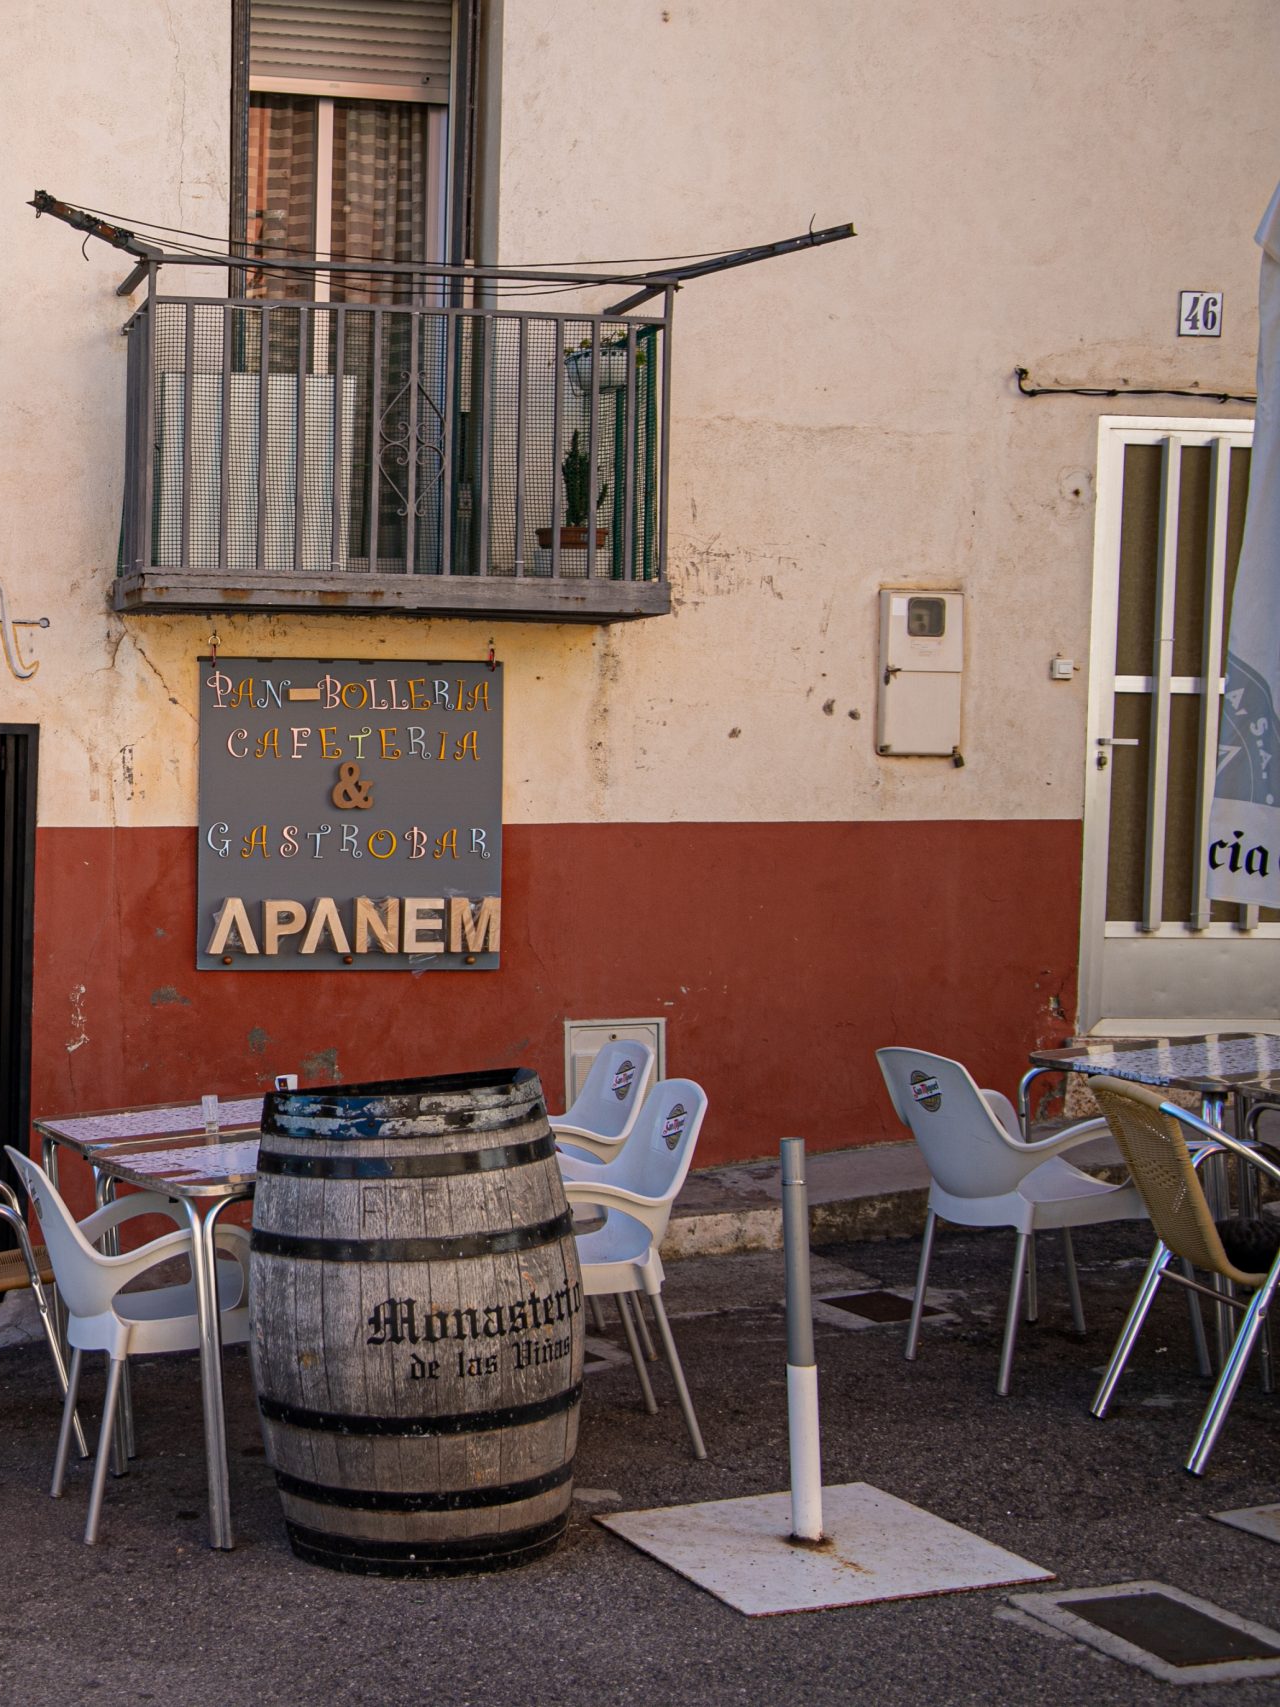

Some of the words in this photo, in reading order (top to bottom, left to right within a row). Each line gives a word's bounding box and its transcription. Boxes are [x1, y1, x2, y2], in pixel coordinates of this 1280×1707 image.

[1184, 296, 1218, 331] 46
[227, 726, 481, 761] CAFETERIA
[332, 760, 374, 809] &
[207, 821, 491, 860] GASTROBAR
[208, 896, 501, 955] APANEM
[410, 1353, 440, 1380] de
[458, 1352, 498, 1378] las
